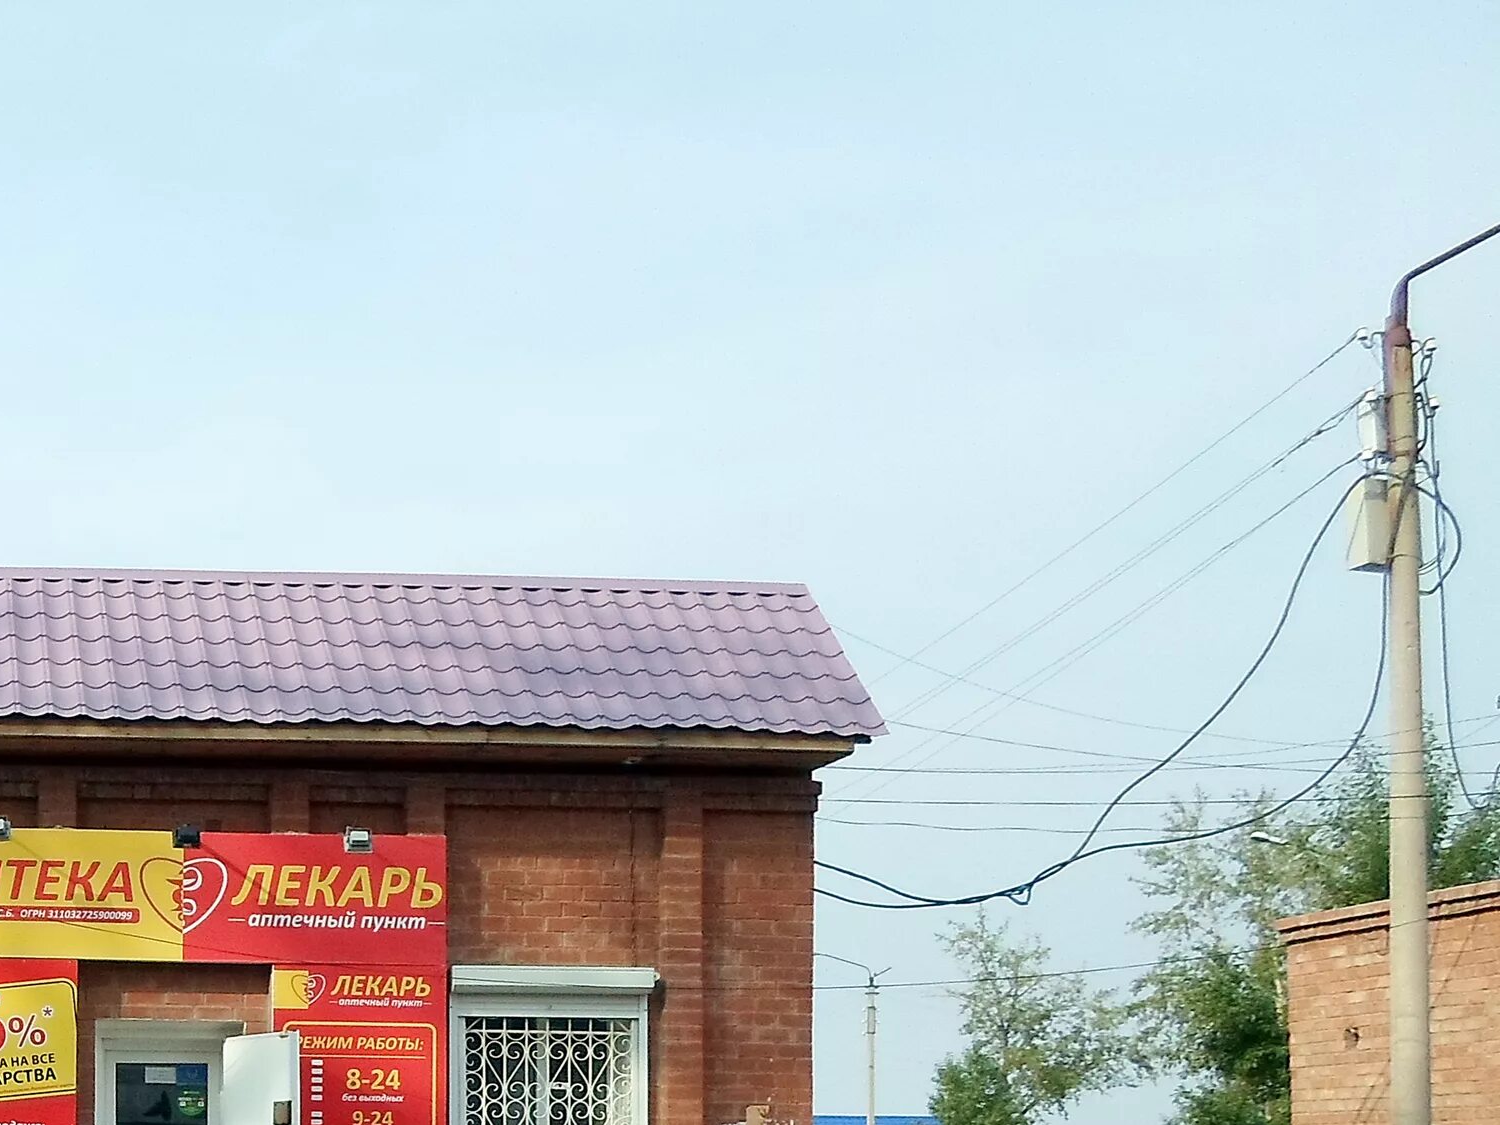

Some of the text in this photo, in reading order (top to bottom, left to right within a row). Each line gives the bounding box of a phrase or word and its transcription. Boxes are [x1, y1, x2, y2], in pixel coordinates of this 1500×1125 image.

[231, 864, 444, 909] ЛЕКАРЬ
[20, 909, 46, 919] ОГРН
[47, 909, 133, 921] 311032725900099
[248, 910, 426, 933] аптечный пункт
[330, 975, 431, 998] ЛЕКАРЬ
[338, 997, 423, 1009] аптечный пункт
[356, 1037, 425, 1051] РАБОТЫ:
[11, 1056, 30, 1069] НА
[32, 1053, 56, 1066] ВСЕ
[346, 1068, 401, 1090] 8-24
[342, 1093, 405, 1103] без выходных
